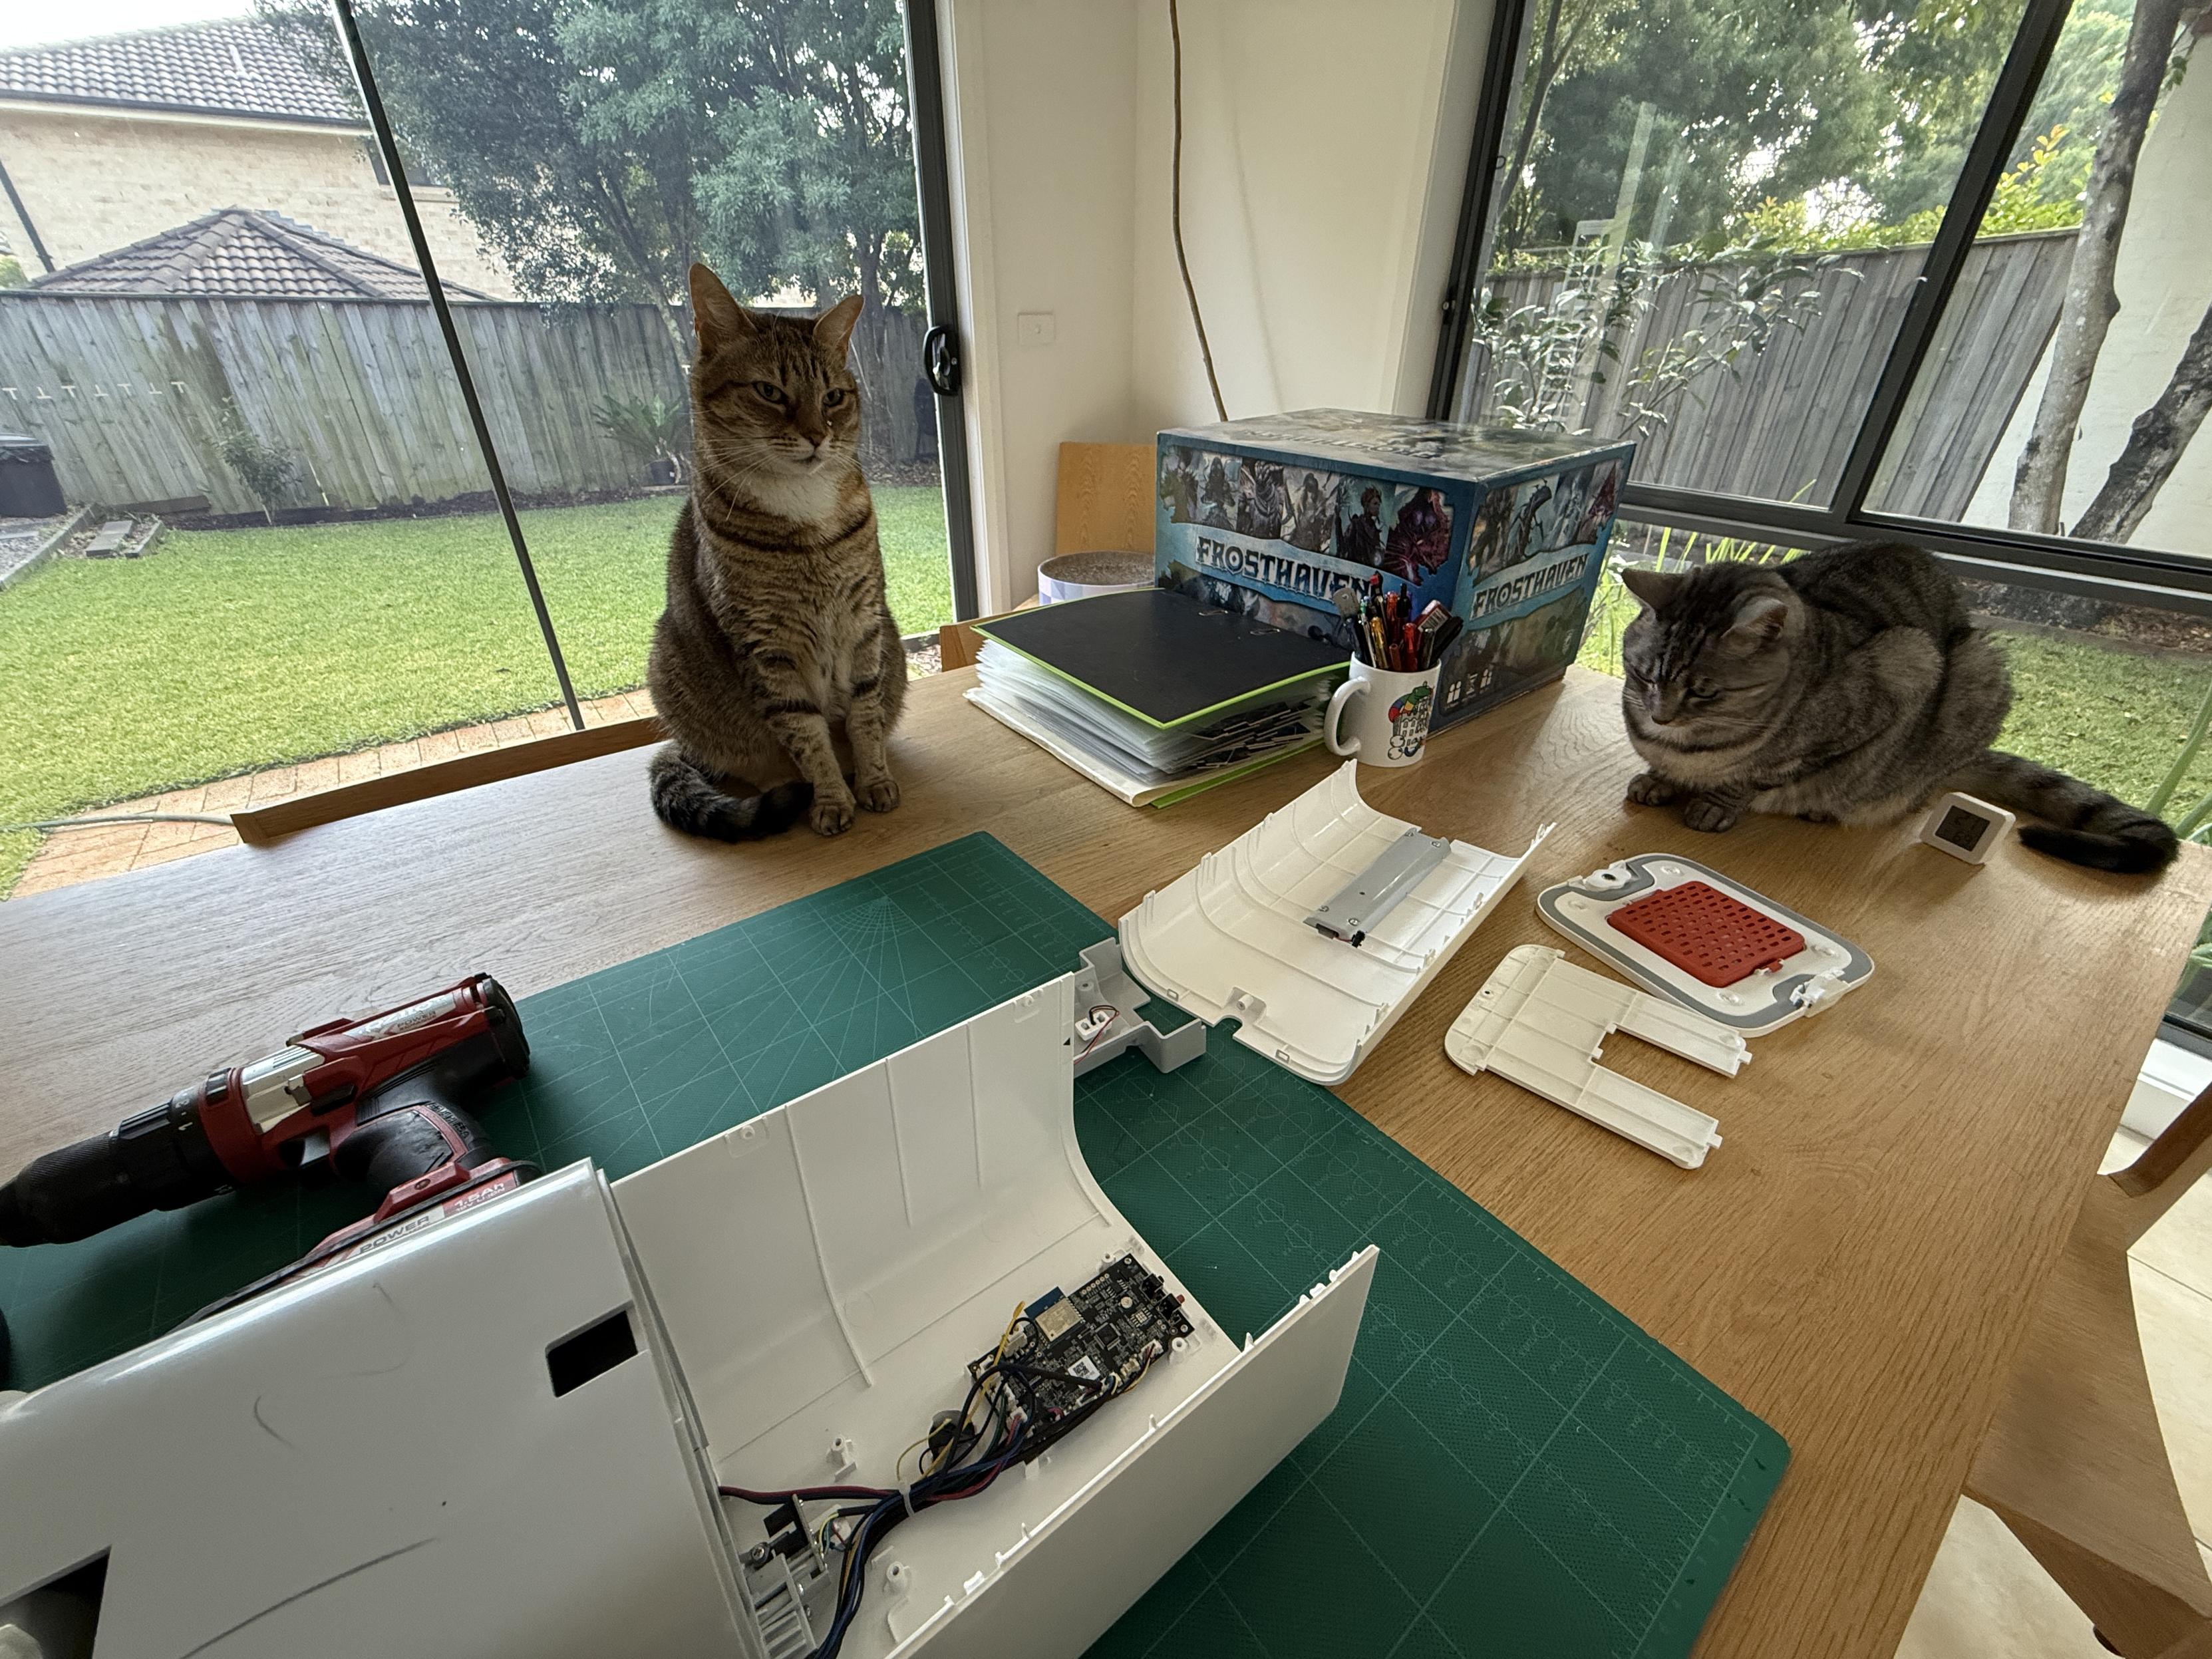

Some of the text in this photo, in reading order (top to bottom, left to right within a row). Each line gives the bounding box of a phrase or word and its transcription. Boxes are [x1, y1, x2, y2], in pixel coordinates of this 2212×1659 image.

[1470, 553, 1589, 621] FROSTHAVEN
[454, 1183, 504, 1206] 1.5Ah
[360, 1215, 430, 1254] POWER
